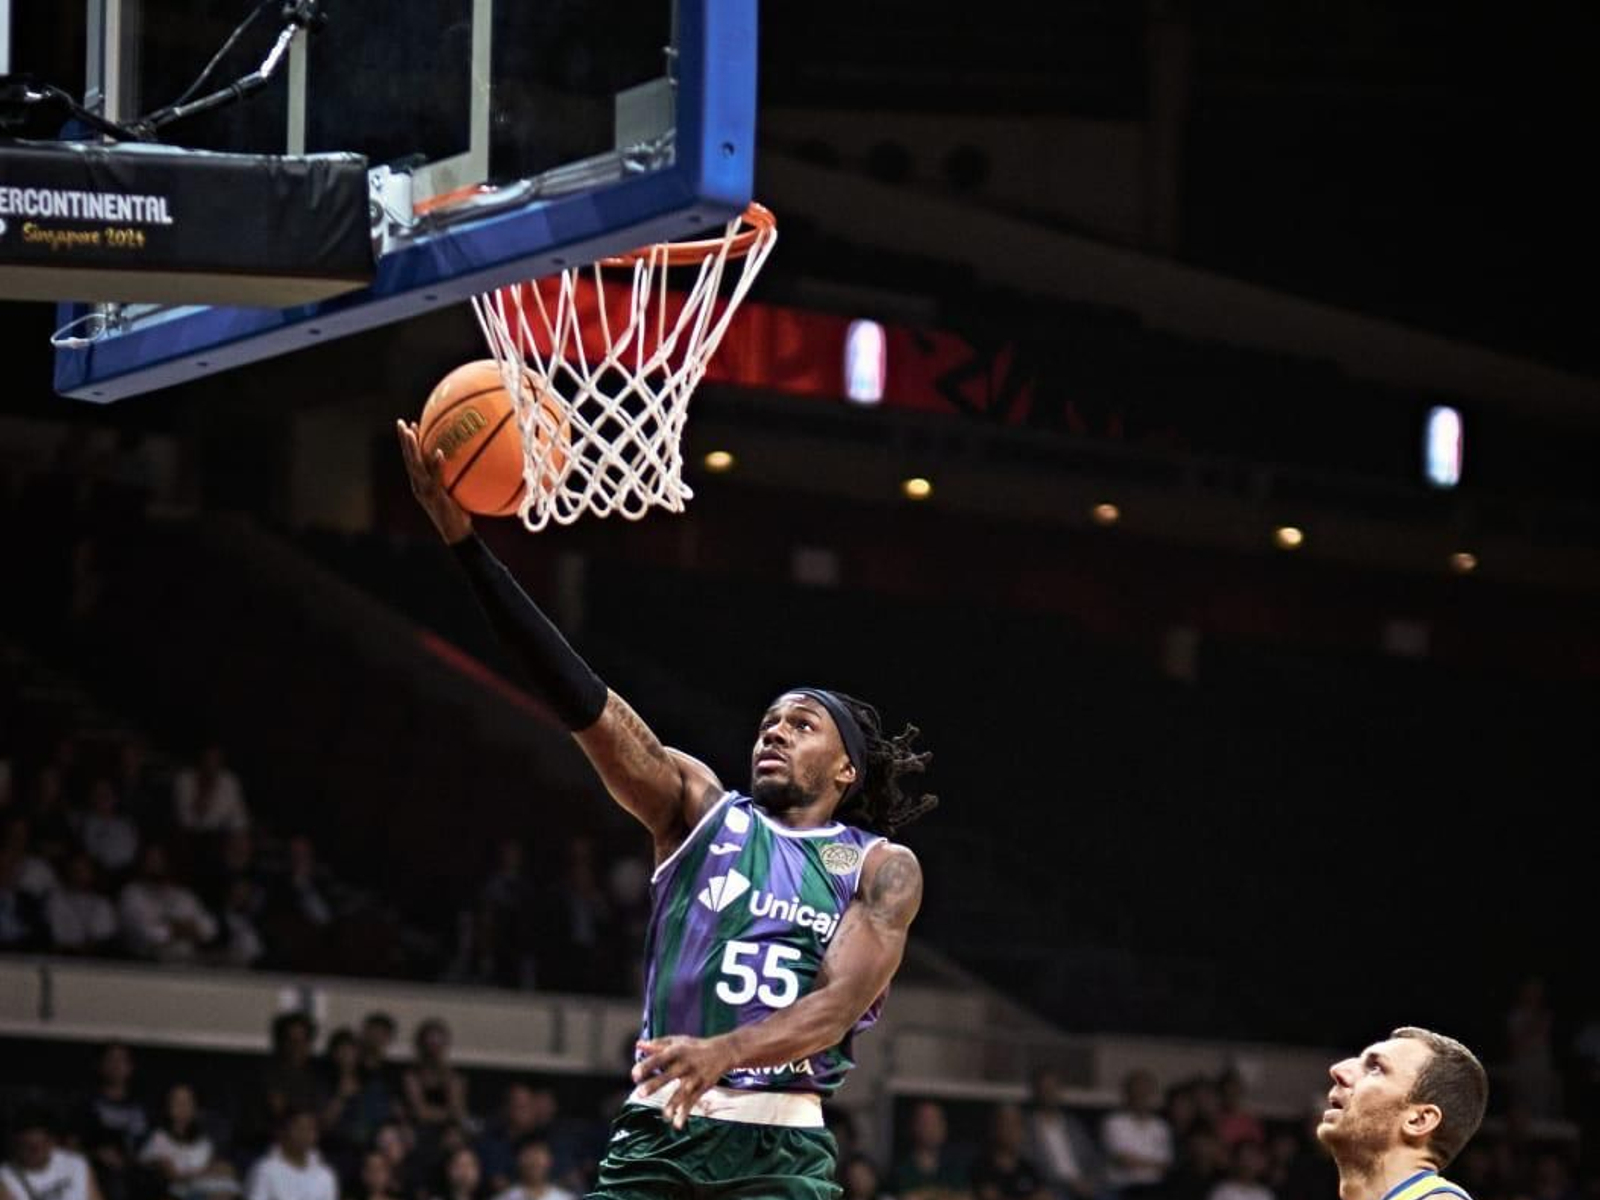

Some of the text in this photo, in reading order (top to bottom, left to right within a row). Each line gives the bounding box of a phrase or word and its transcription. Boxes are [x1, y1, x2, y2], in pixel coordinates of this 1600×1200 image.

[0, 186, 173, 225] ERCONTINENTAL
[23, 222, 99, 250] Singapore
[716, 941, 801, 1008] 55
